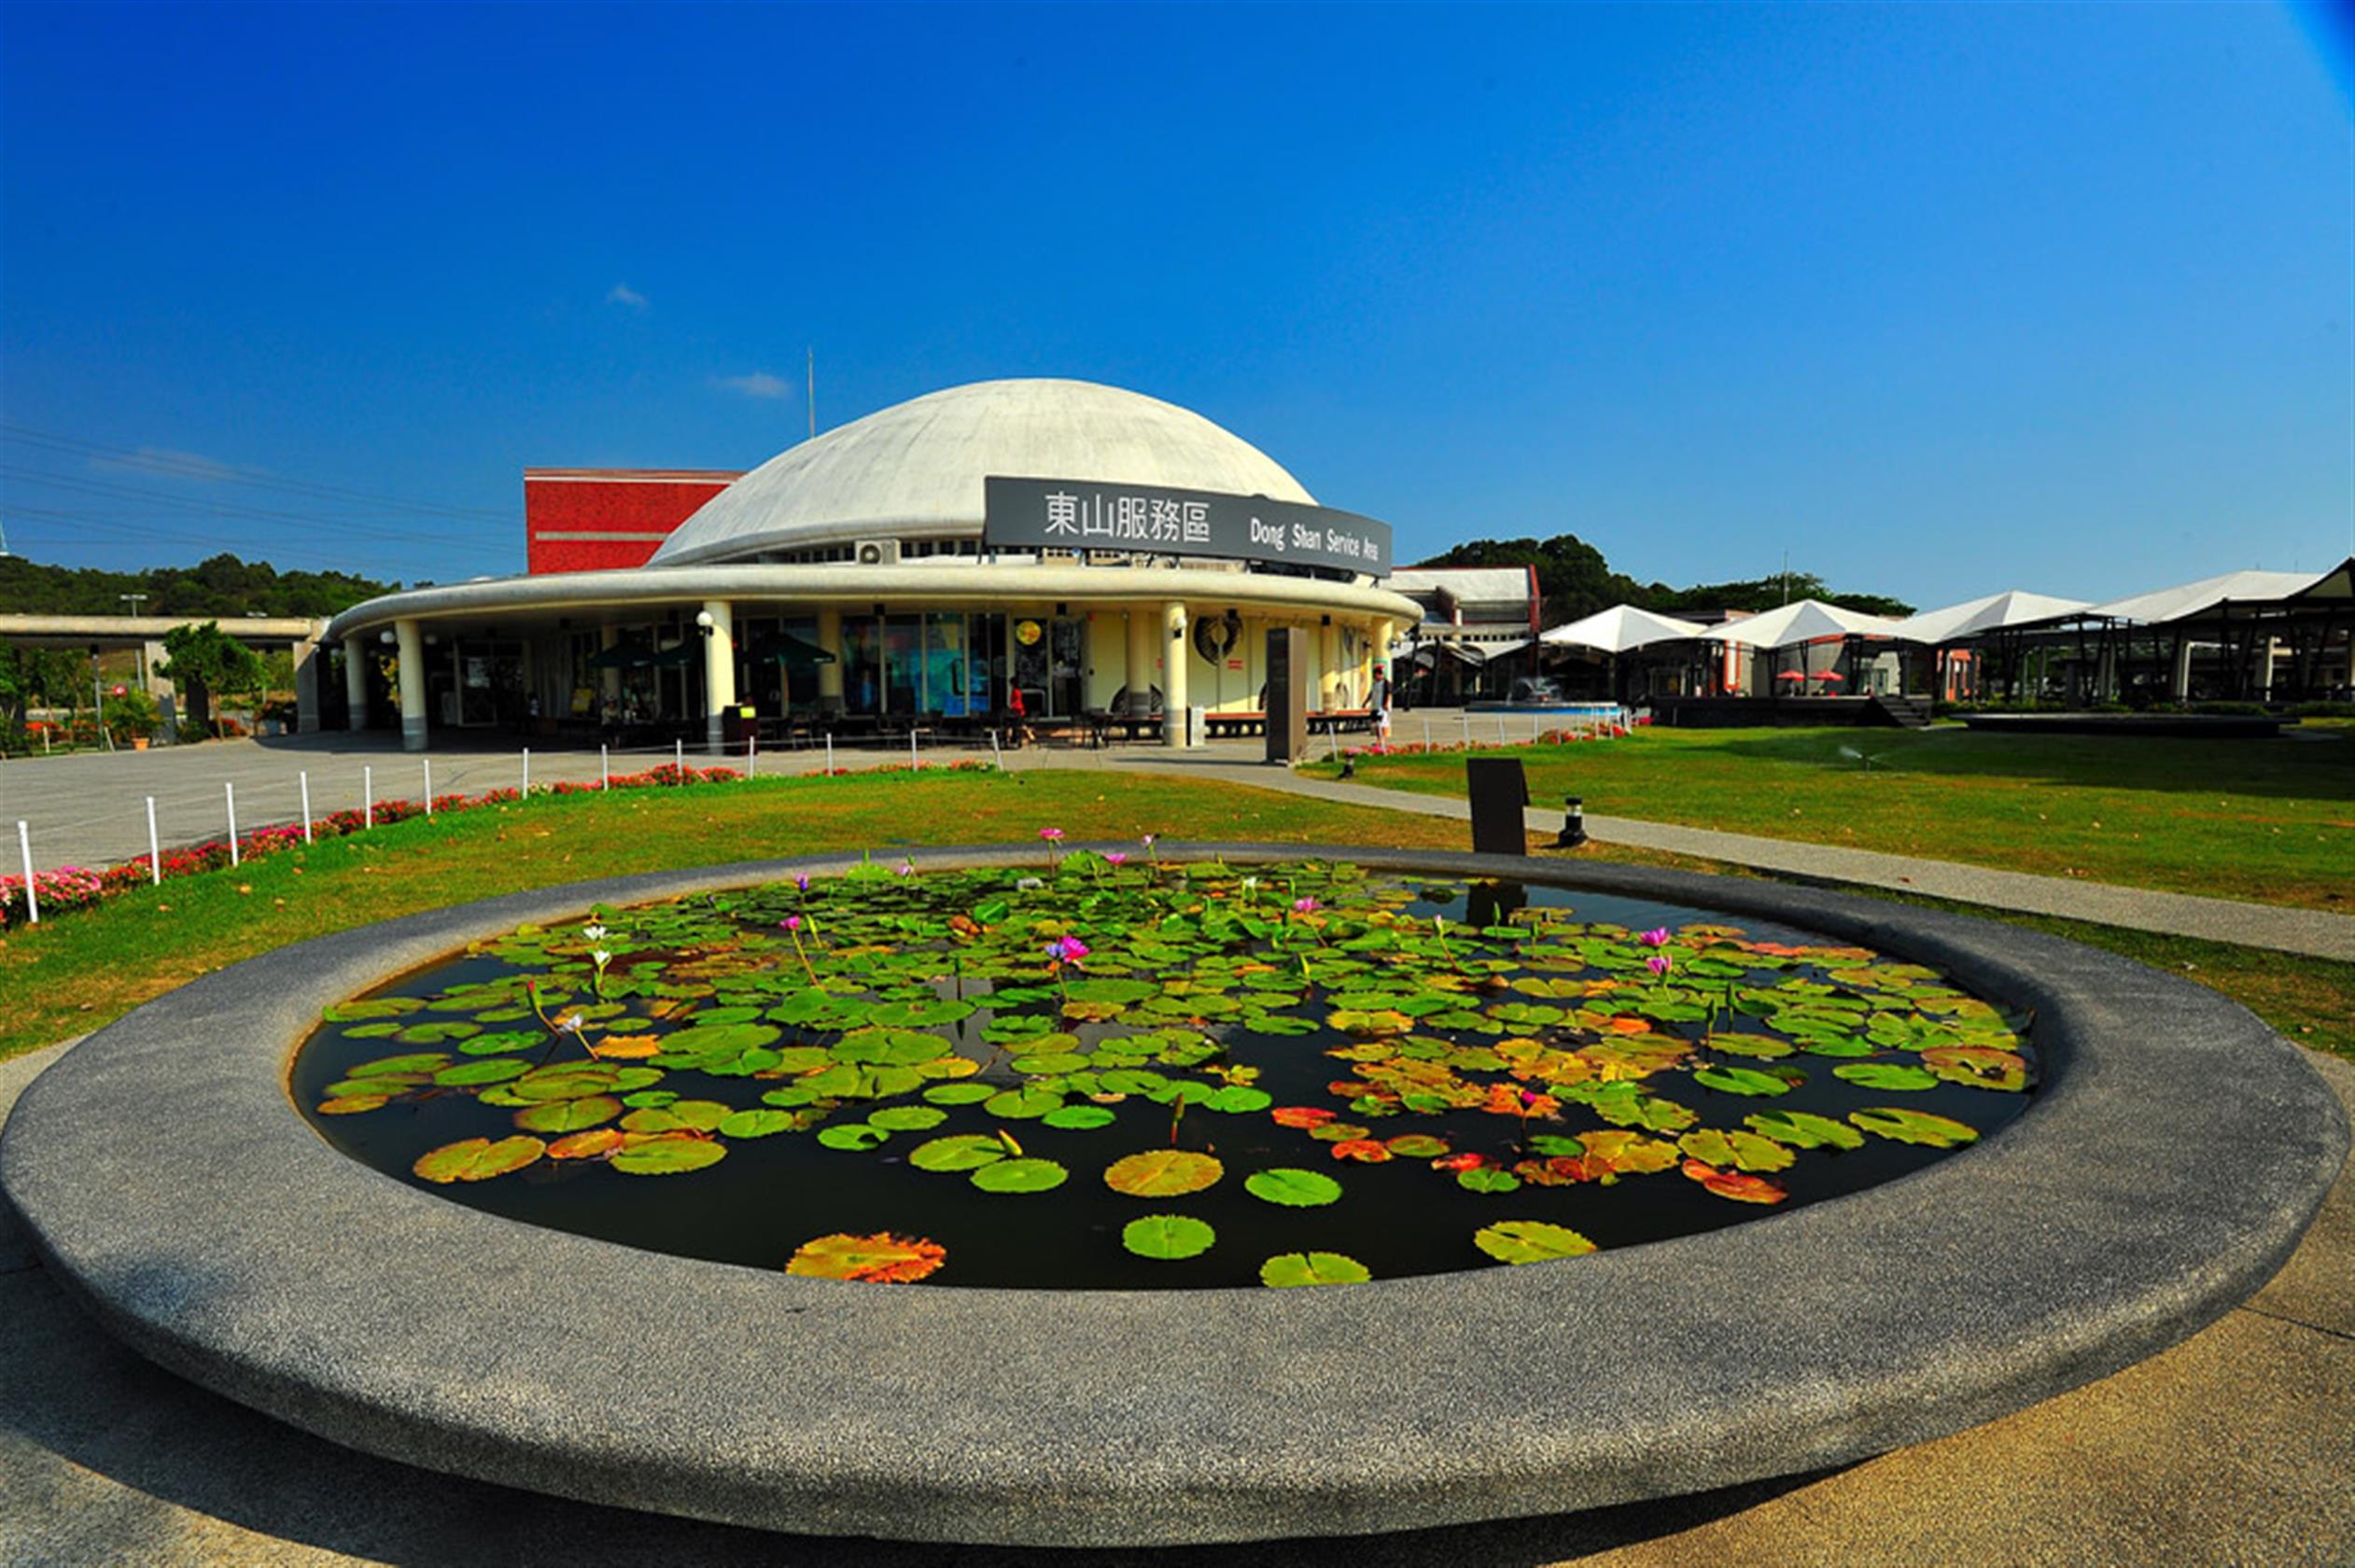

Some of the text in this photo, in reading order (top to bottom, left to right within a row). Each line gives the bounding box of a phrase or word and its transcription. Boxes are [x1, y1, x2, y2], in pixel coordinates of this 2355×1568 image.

[1044, 491, 1210, 542] 東山服務區
[1250, 517, 1379, 562] Dong Shan Service Area
